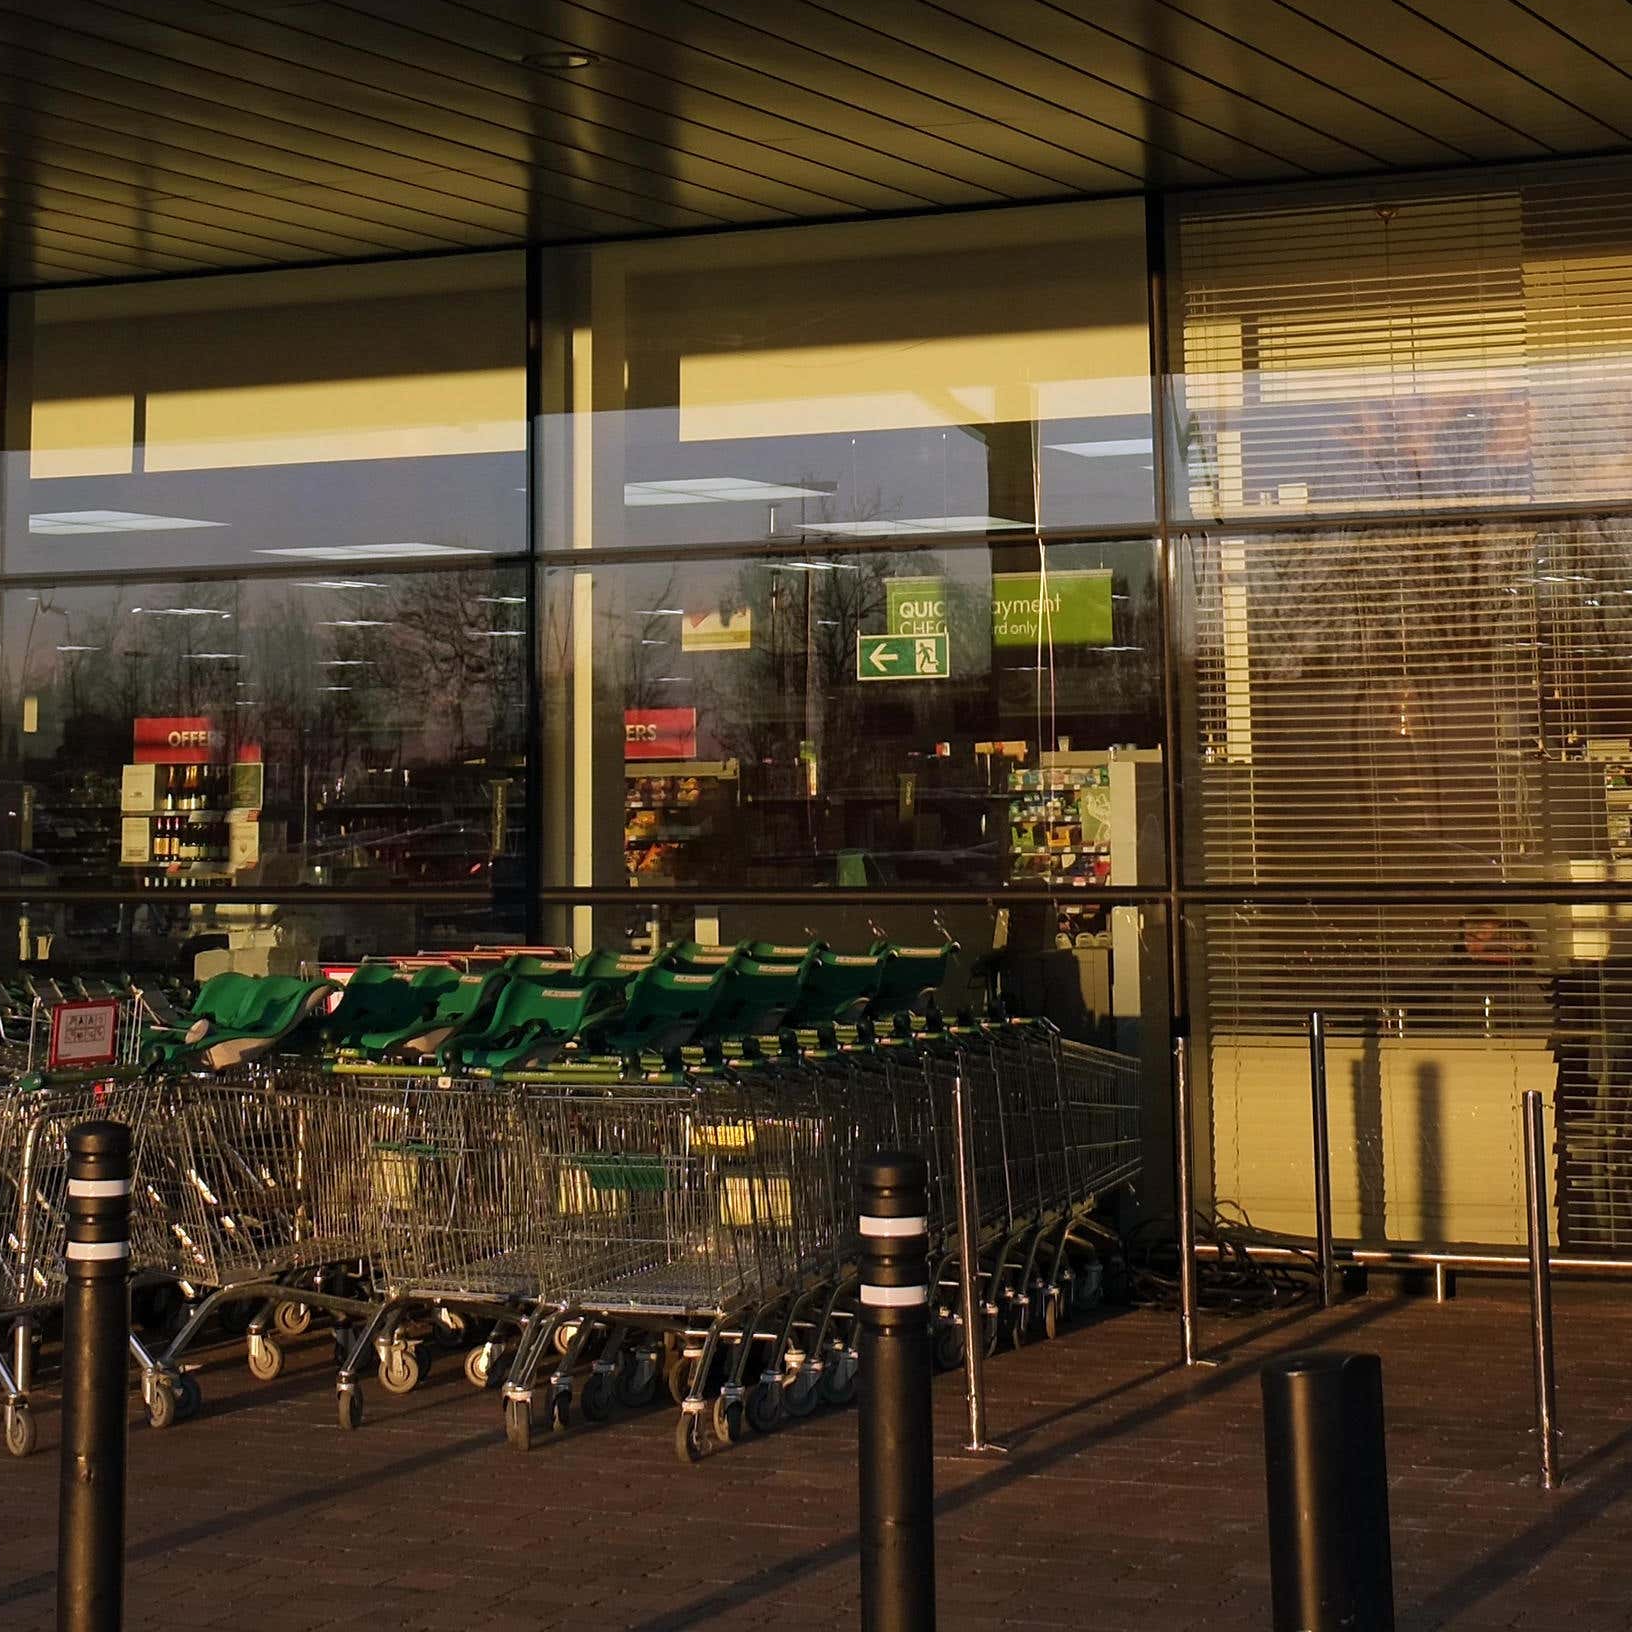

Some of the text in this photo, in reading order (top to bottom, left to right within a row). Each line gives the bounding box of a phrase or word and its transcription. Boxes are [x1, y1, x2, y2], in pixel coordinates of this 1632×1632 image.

[899, 600, 945, 619] QUIC
[992, 592, 1062, 620] ayment
[899, 620, 946, 635] CHEC
[994, 620, 1038, 639] rd only
[625, 724, 657, 741] ERS
